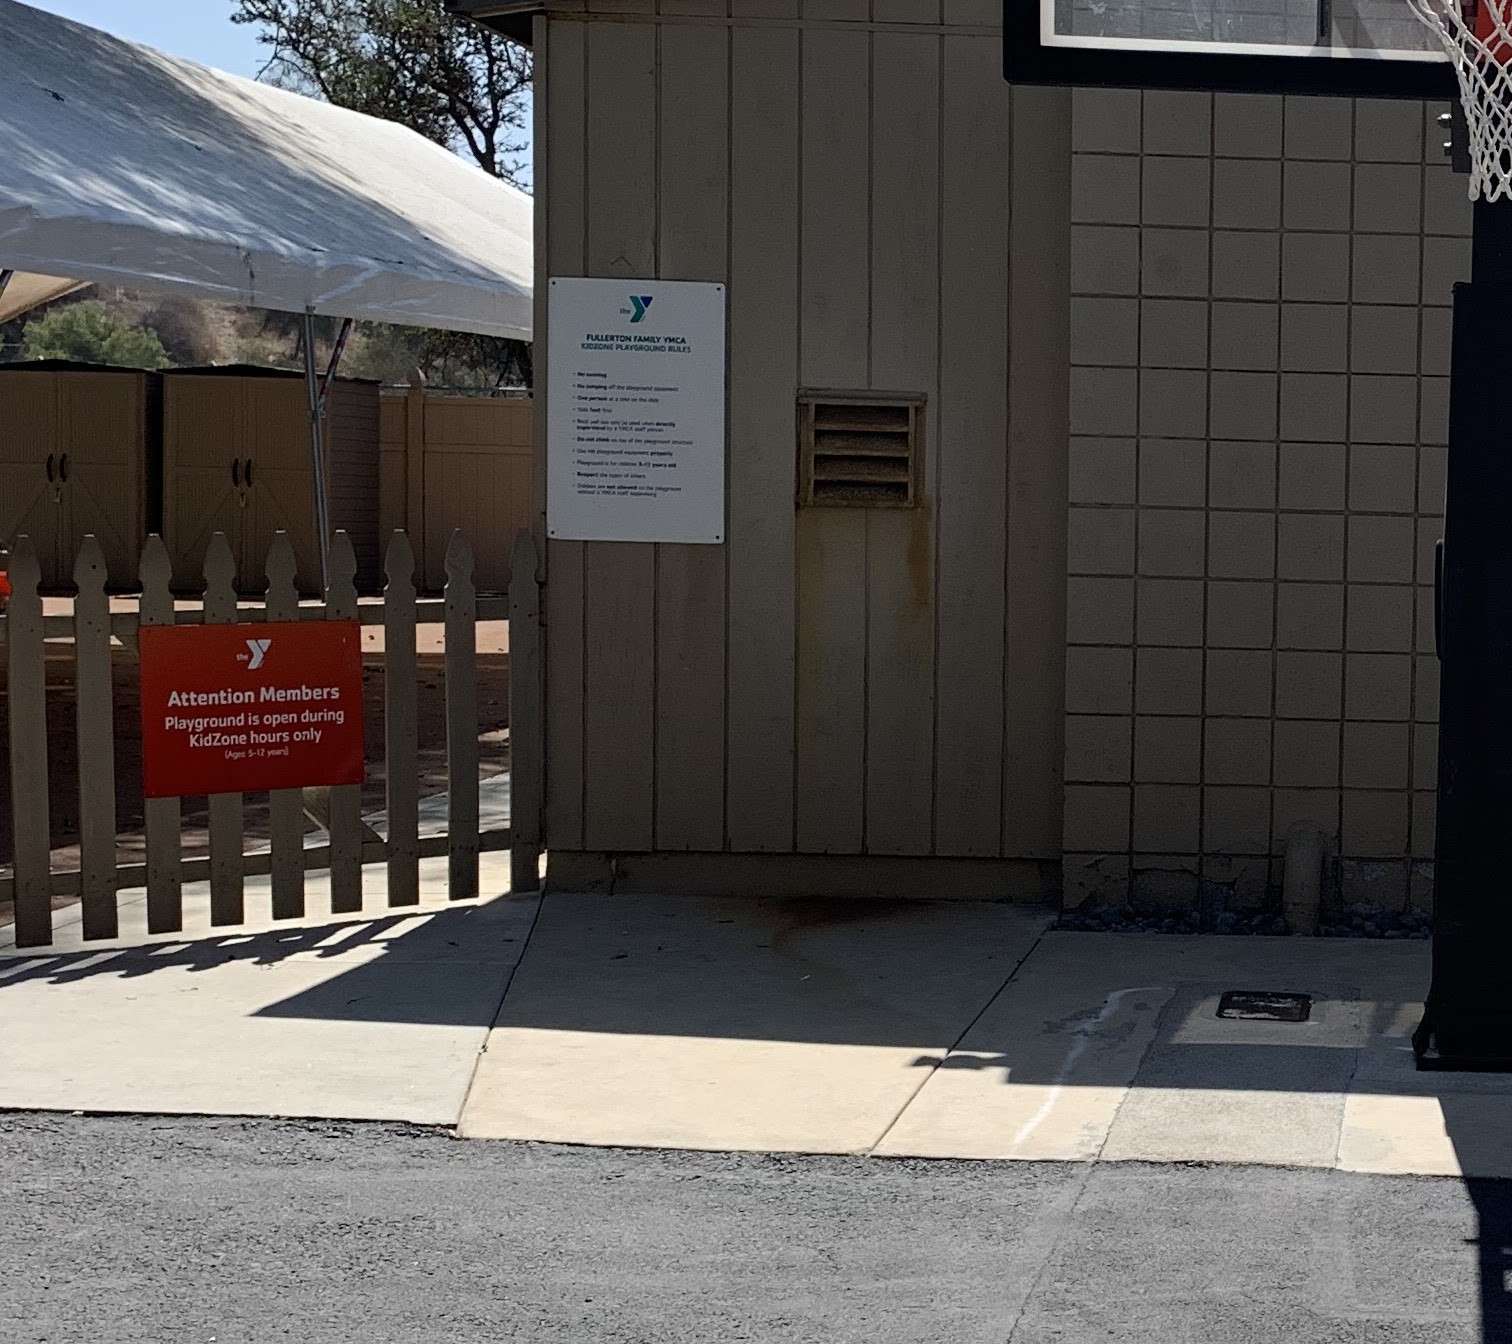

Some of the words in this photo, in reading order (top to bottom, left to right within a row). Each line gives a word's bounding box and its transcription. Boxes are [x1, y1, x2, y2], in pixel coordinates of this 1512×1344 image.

[587, 334, 631, 342] FULLERTON
[664, 336, 686, 344] YMCA
[616, 344, 666, 352] PLAYGROUND
[236, 653, 248, 661] the
[168, 689, 255, 707] Attention
[260, 685, 340, 702] Members
[165, 713, 244, 731] Playground
[248, 713, 259, 725] is
[263, 714, 297, 728] open
[301, 709, 344, 725] during
[190, 733, 247, 747] KidZone
[250, 730, 289, 744] hours
[293, 728, 322, 743] only
[248, 749, 265, 757] 5-12
